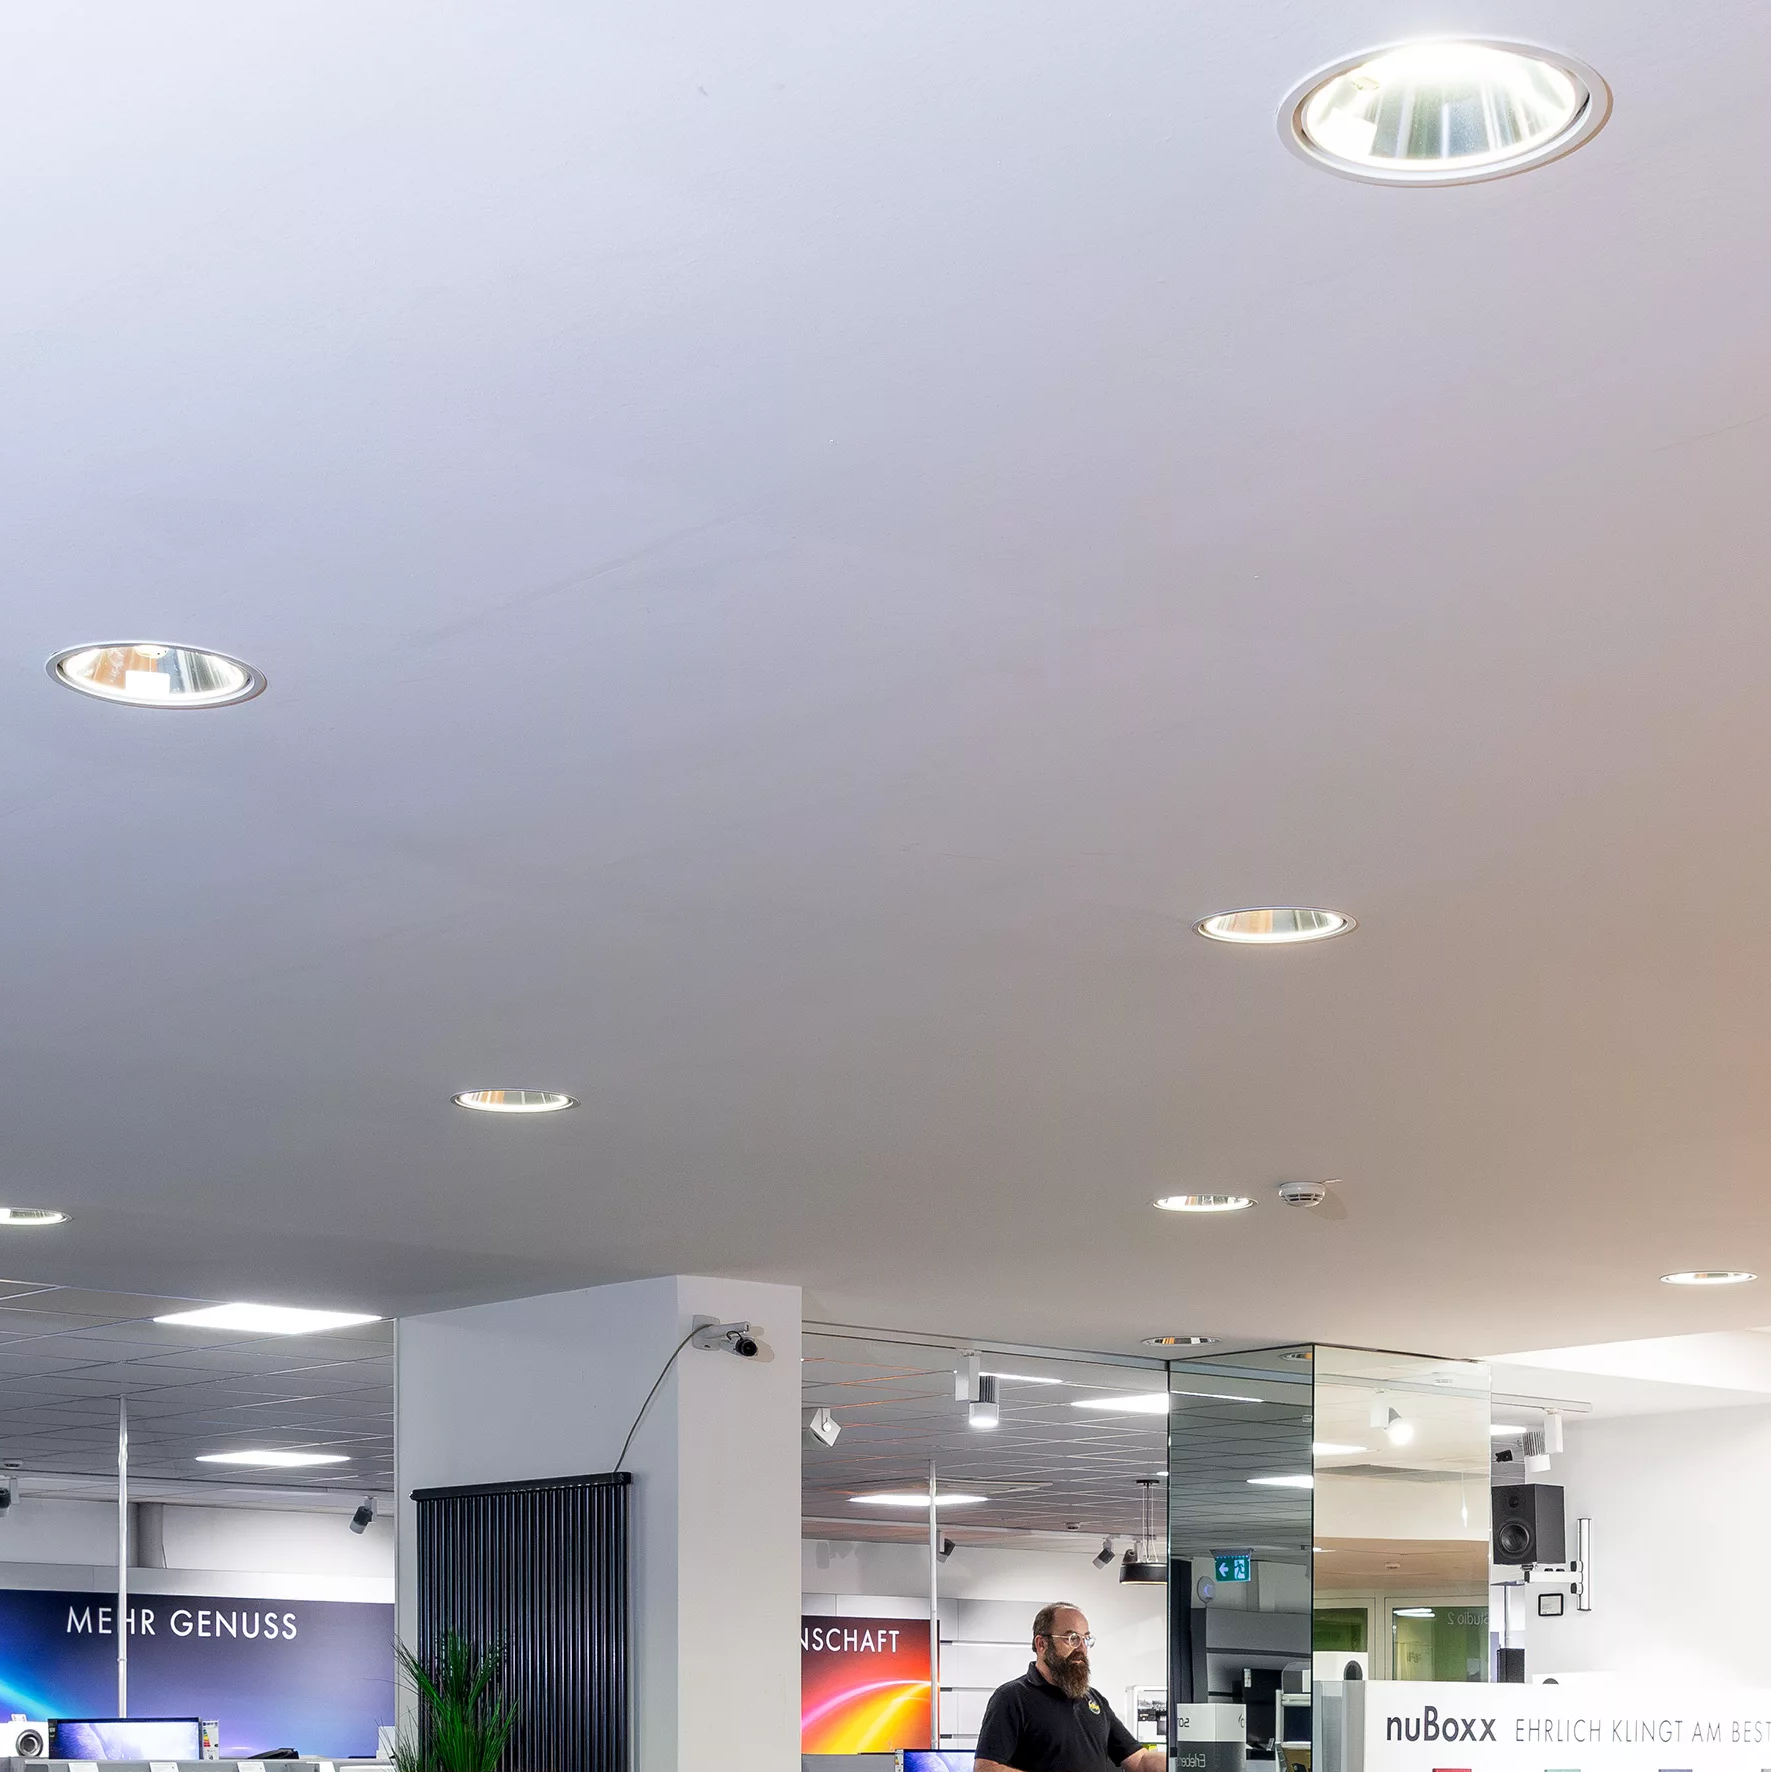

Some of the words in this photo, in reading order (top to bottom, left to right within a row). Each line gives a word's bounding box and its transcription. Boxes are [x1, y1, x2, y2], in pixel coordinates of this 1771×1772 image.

[67, 1606, 155, 1635] MEHR
[170, 1609, 297, 1640] GENUSS
[801, 1627, 900, 1653] NSCHAFT
[1386, 1705, 1497, 1742] nuBoxx
[1516, 1718, 1601, 1742] EHRLICH
[1612, 1719, 1683, 1743] KLINGT
[1692, 1721, 1721, 1743] AM
